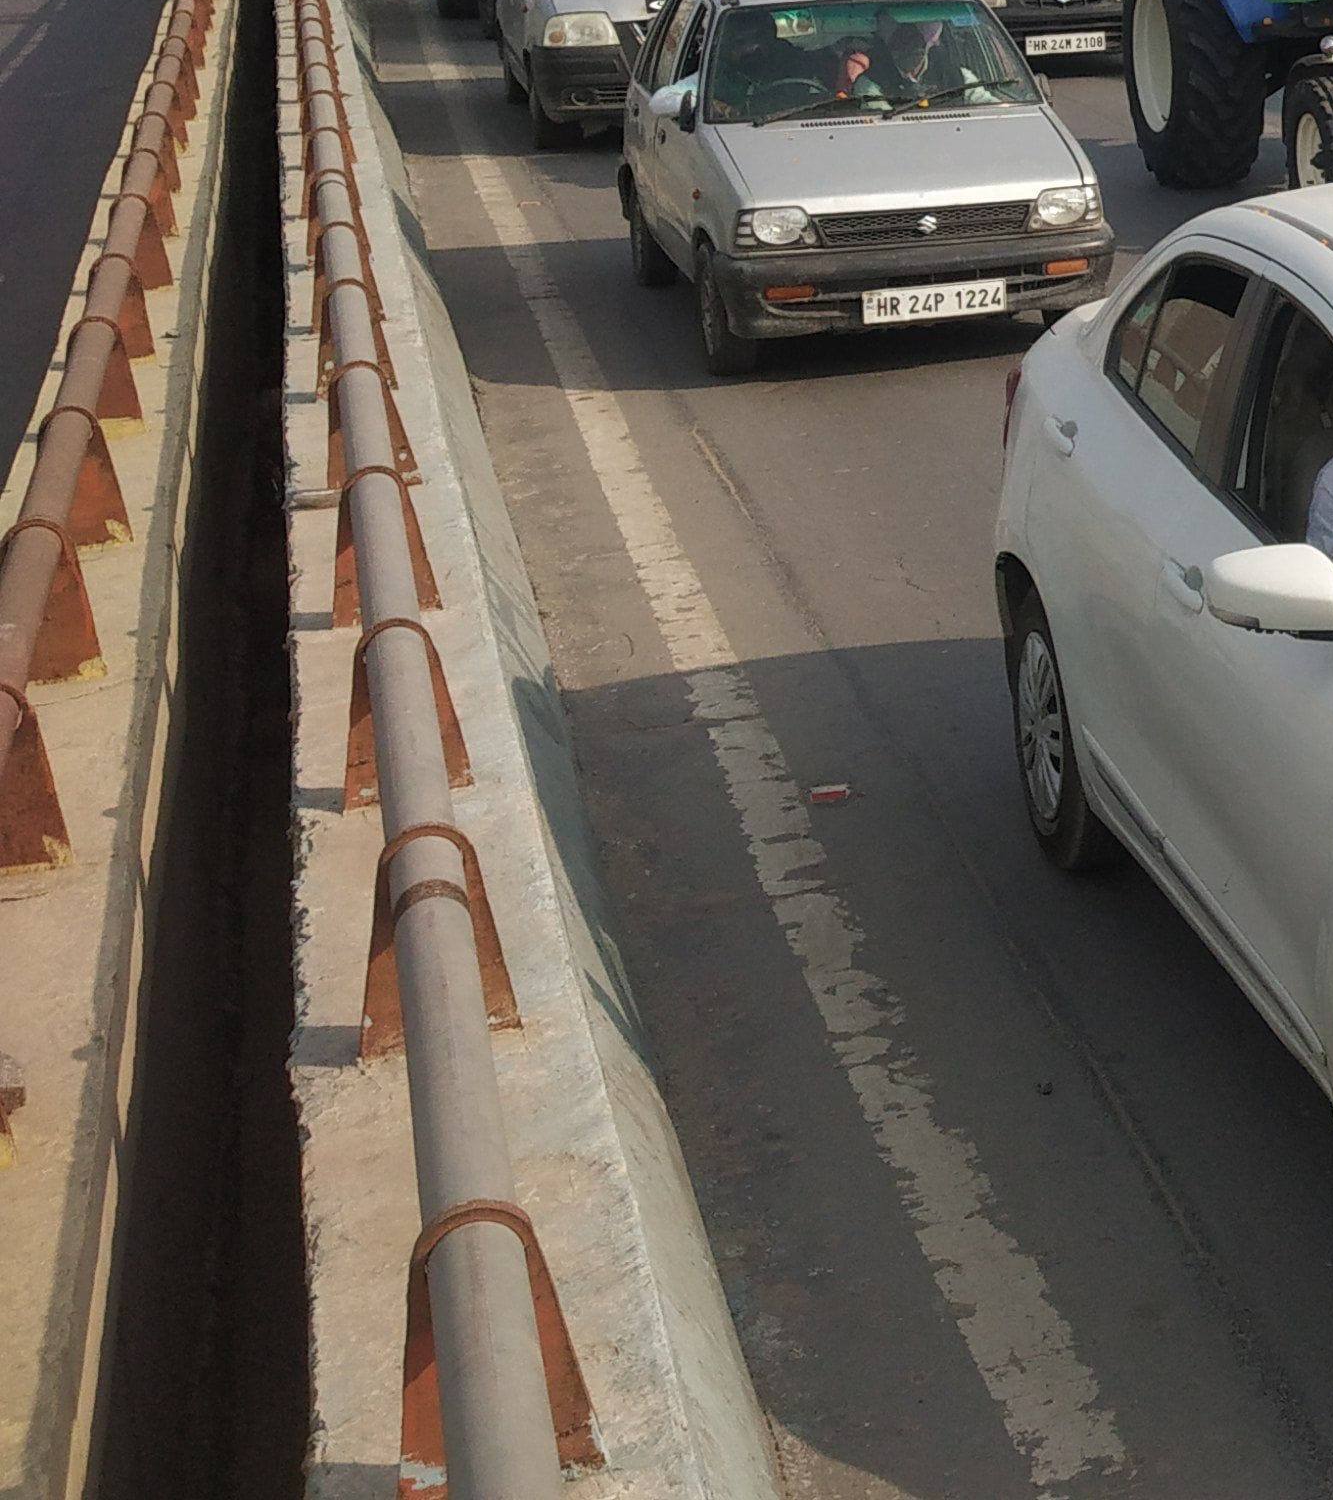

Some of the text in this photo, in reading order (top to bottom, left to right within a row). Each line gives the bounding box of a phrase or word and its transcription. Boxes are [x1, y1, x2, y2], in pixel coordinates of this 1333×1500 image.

[1033, 40, 1047, 52] HR
[1076, 36, 1103, 49] 2108
[877, 286, 1002, 317] HR 24P 1224
